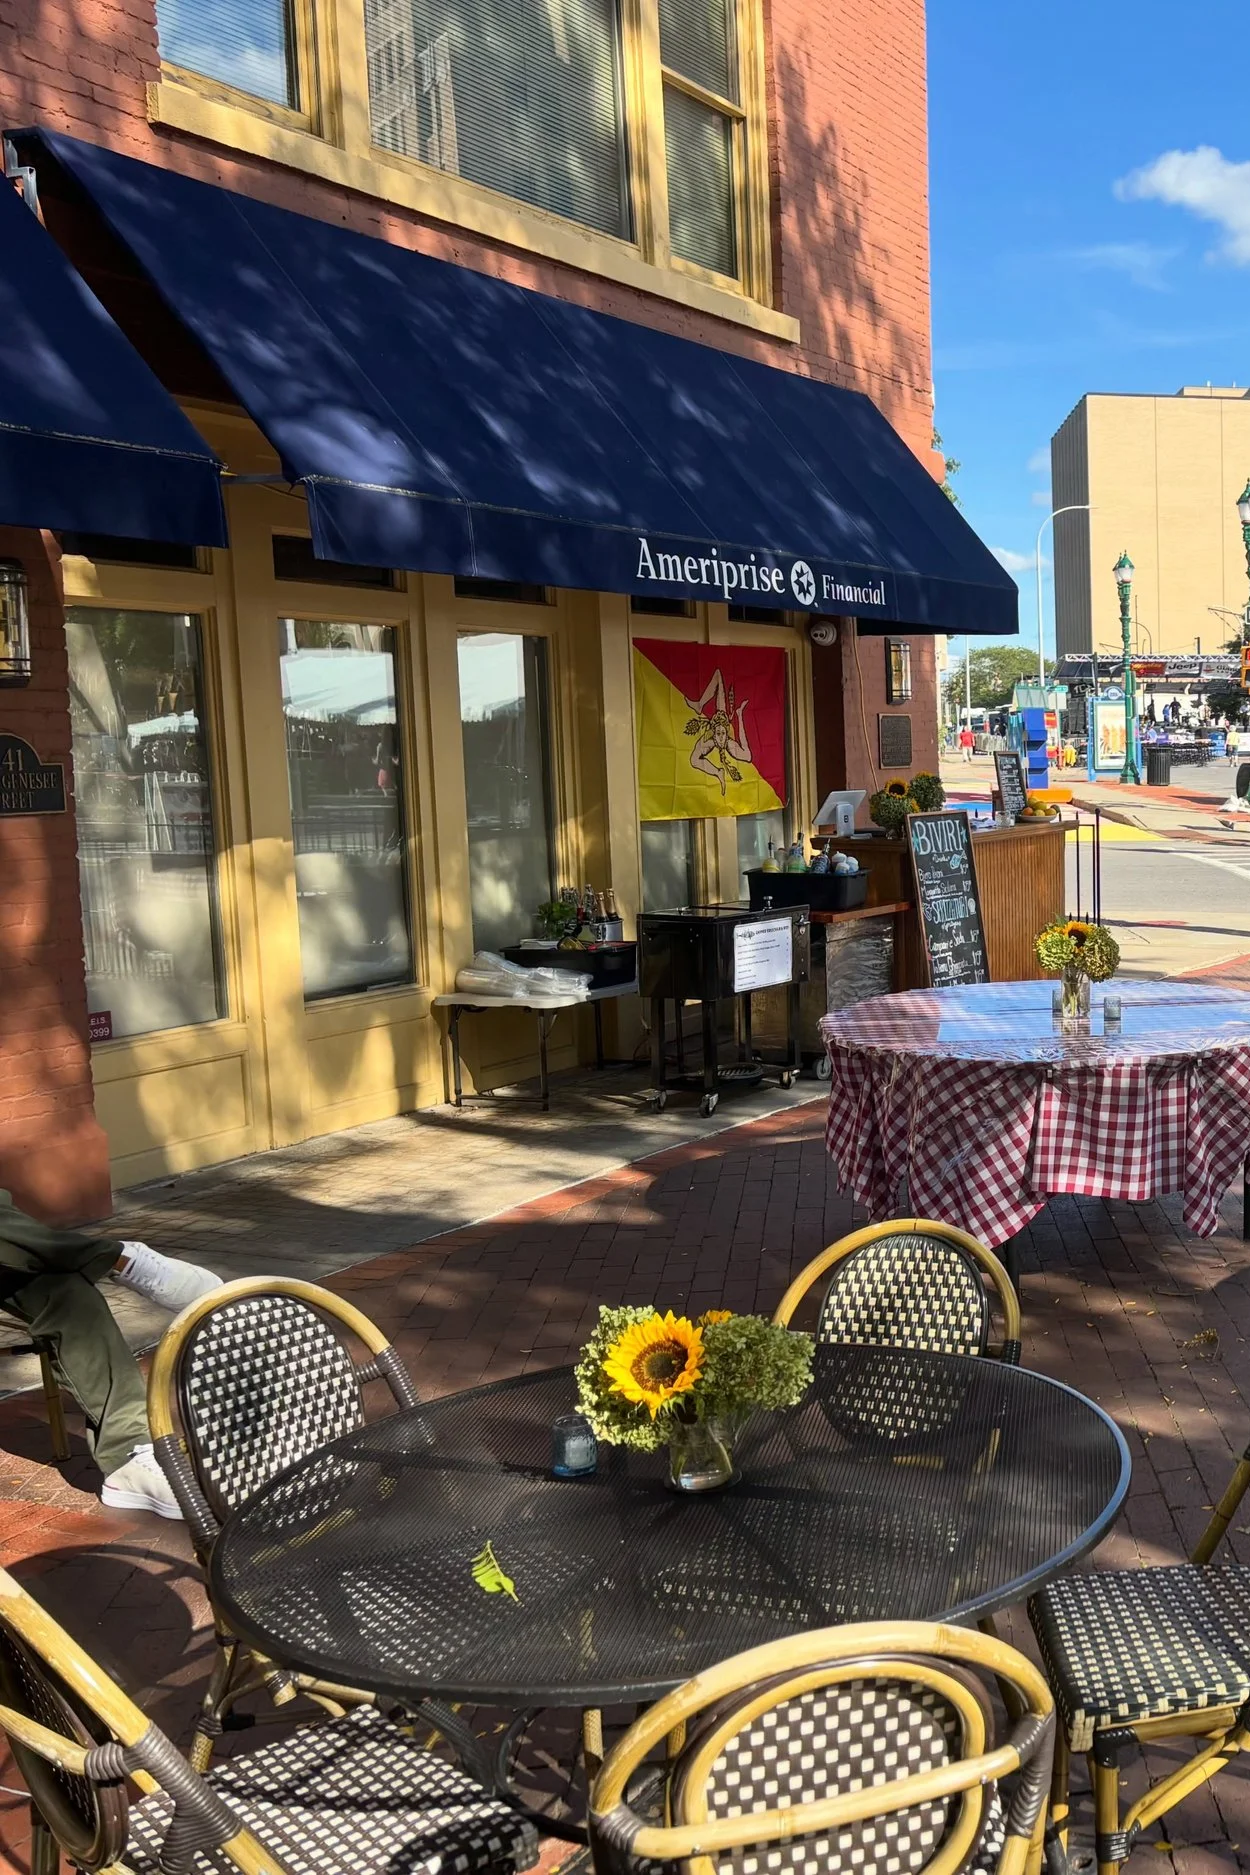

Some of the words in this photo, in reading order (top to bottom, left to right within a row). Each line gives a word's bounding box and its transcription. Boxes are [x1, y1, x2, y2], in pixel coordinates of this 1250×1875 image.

[636, 537, 786, 600] Ameriprise
[821, 573, 886, 606] Financial
[1168, 662, 1198, 672] Jeep
[2, 772, 57, 790] GENESEE
[914, 819, 964, 856] BIVIRI
